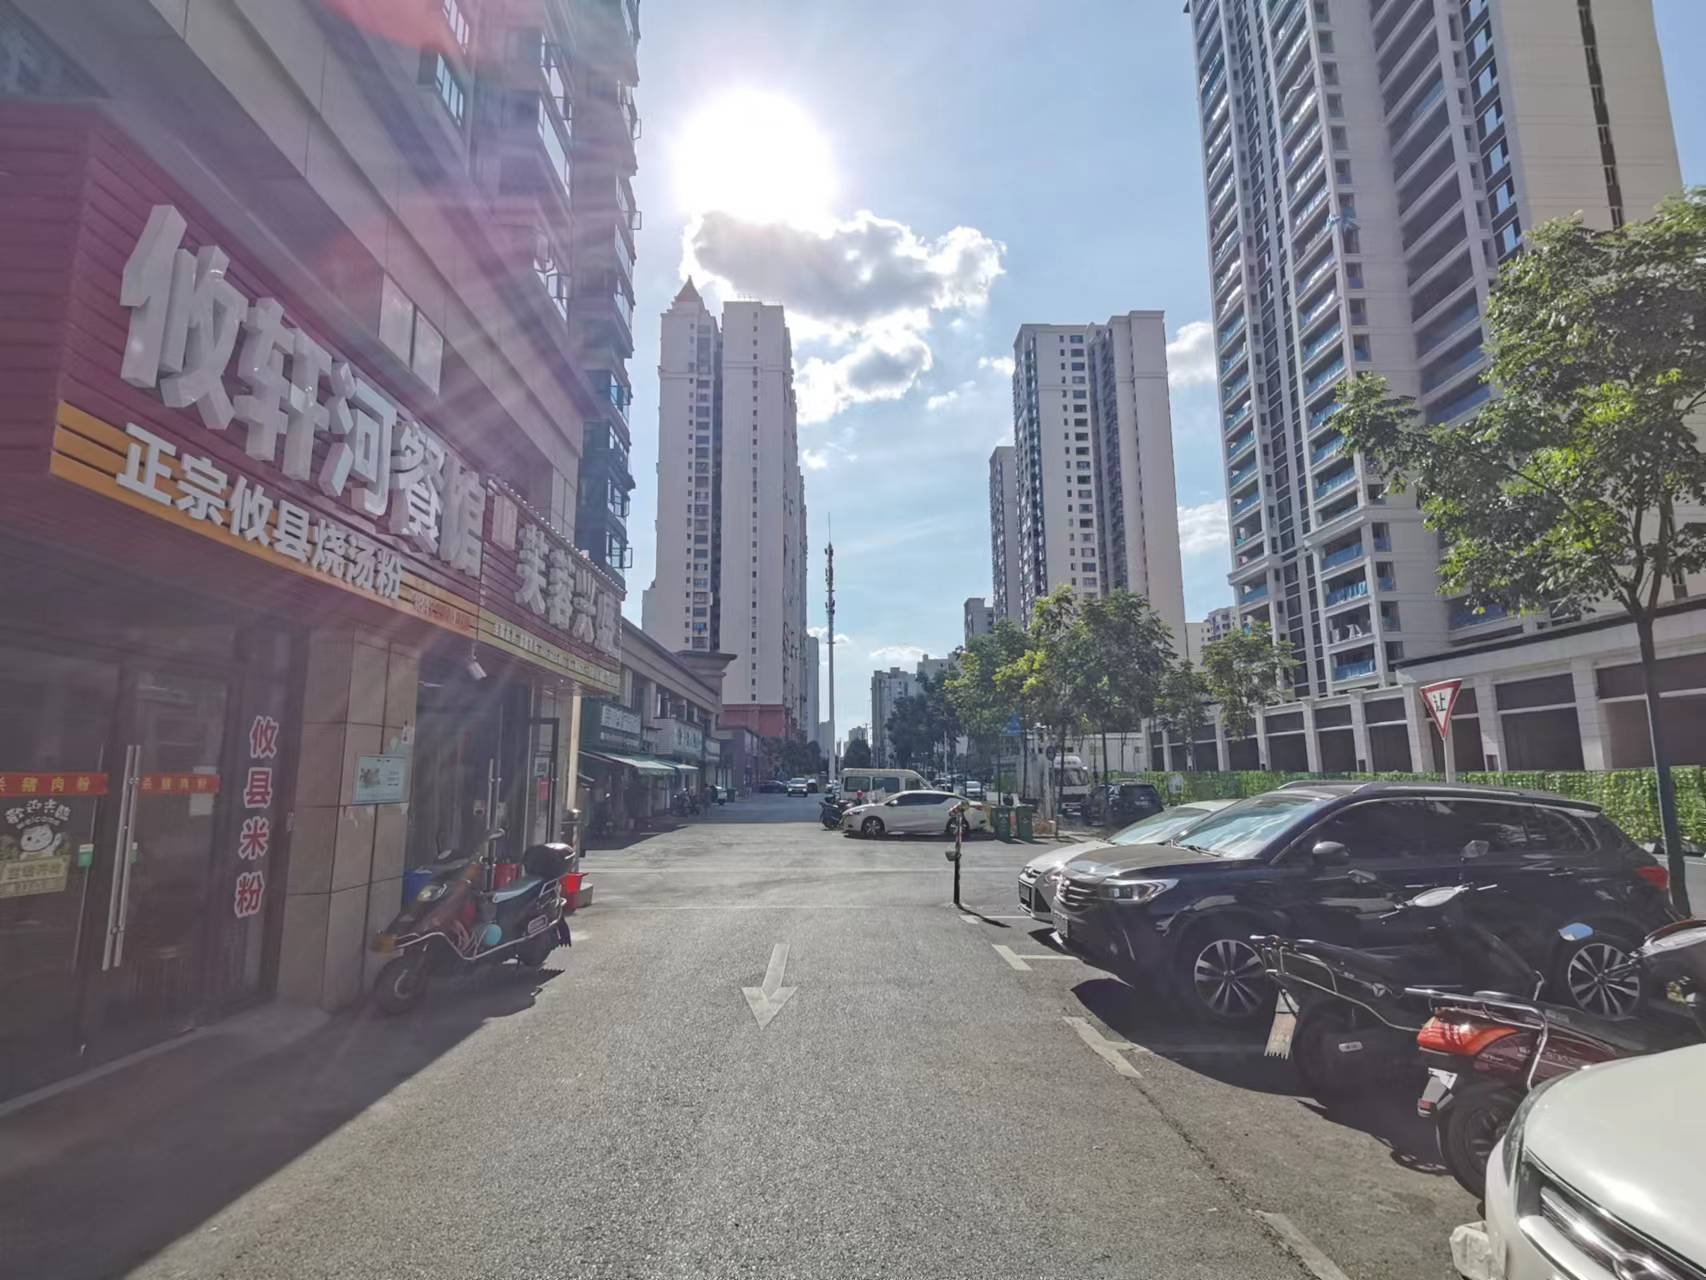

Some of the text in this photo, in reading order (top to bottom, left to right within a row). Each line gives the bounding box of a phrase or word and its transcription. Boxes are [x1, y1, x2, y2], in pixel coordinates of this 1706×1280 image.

[119, 204, 486, 579] 攸轩河餐馆
[116, 422, 402, 600] 正宗攸县烧汤粉
[1433, 692, 1446, 712] 让
[235, 715, 279, 918] 攸县米粉
